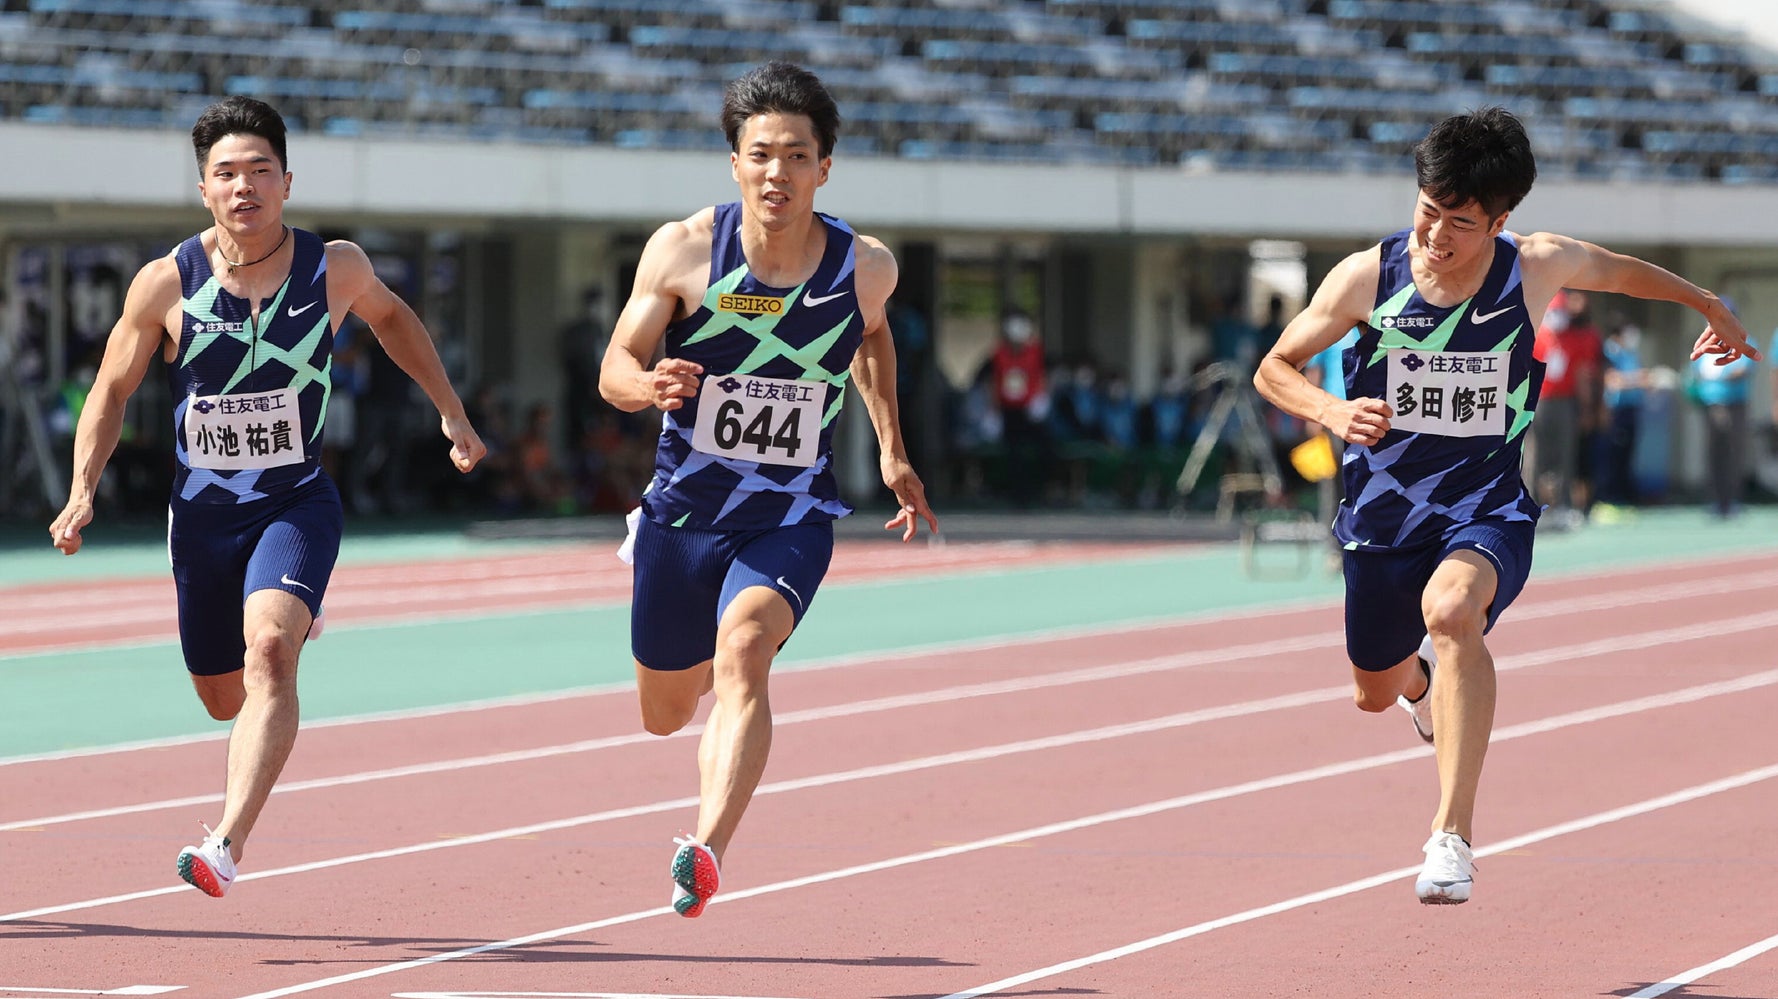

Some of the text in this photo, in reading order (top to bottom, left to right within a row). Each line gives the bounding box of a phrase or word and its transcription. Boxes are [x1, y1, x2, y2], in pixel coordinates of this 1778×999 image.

[720, 296, 782, 313] SEIKO
[206, 322, 243, 332] 住友電工
[1396, 317, 1434, 328] 住友電工
[1428, 355, 1498, 374] 住友電工
[745, 380, 814, 402] 住友電工
[218, 394, 287, 415] 住友電工
[1396, 382, 1498, 424] 多田 修平
[196, 420, 293, 457] 小池 祐貴
[714, 399, 802, 458] 644
